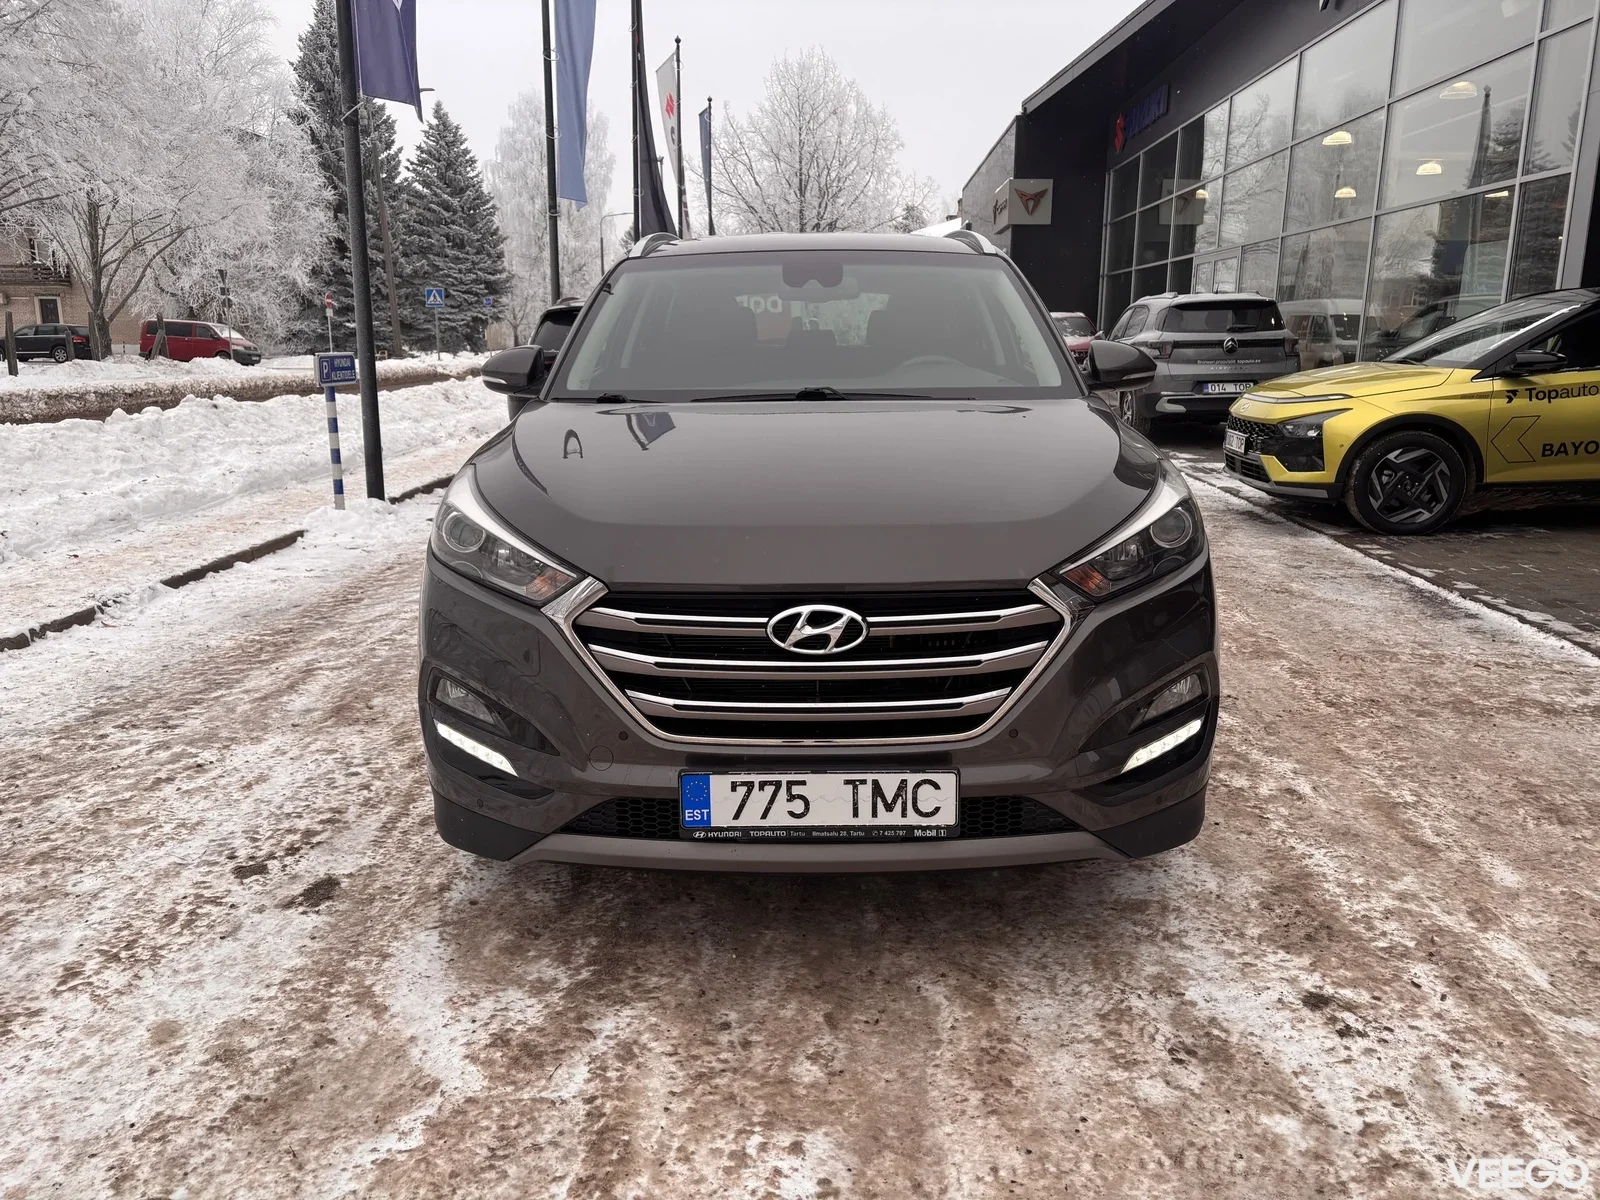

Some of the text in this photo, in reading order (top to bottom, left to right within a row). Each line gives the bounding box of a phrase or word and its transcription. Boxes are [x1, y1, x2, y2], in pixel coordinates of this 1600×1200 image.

[322, 361, 329, 379] P
[1210, 383, 1226, 392] 014
[1525, 383, 1599, 403] Topauto
[731, 779, 942, 820] 775 TMC
[685, 809, 709, 820] EST
[914, 829, 937, 837] Mobil
